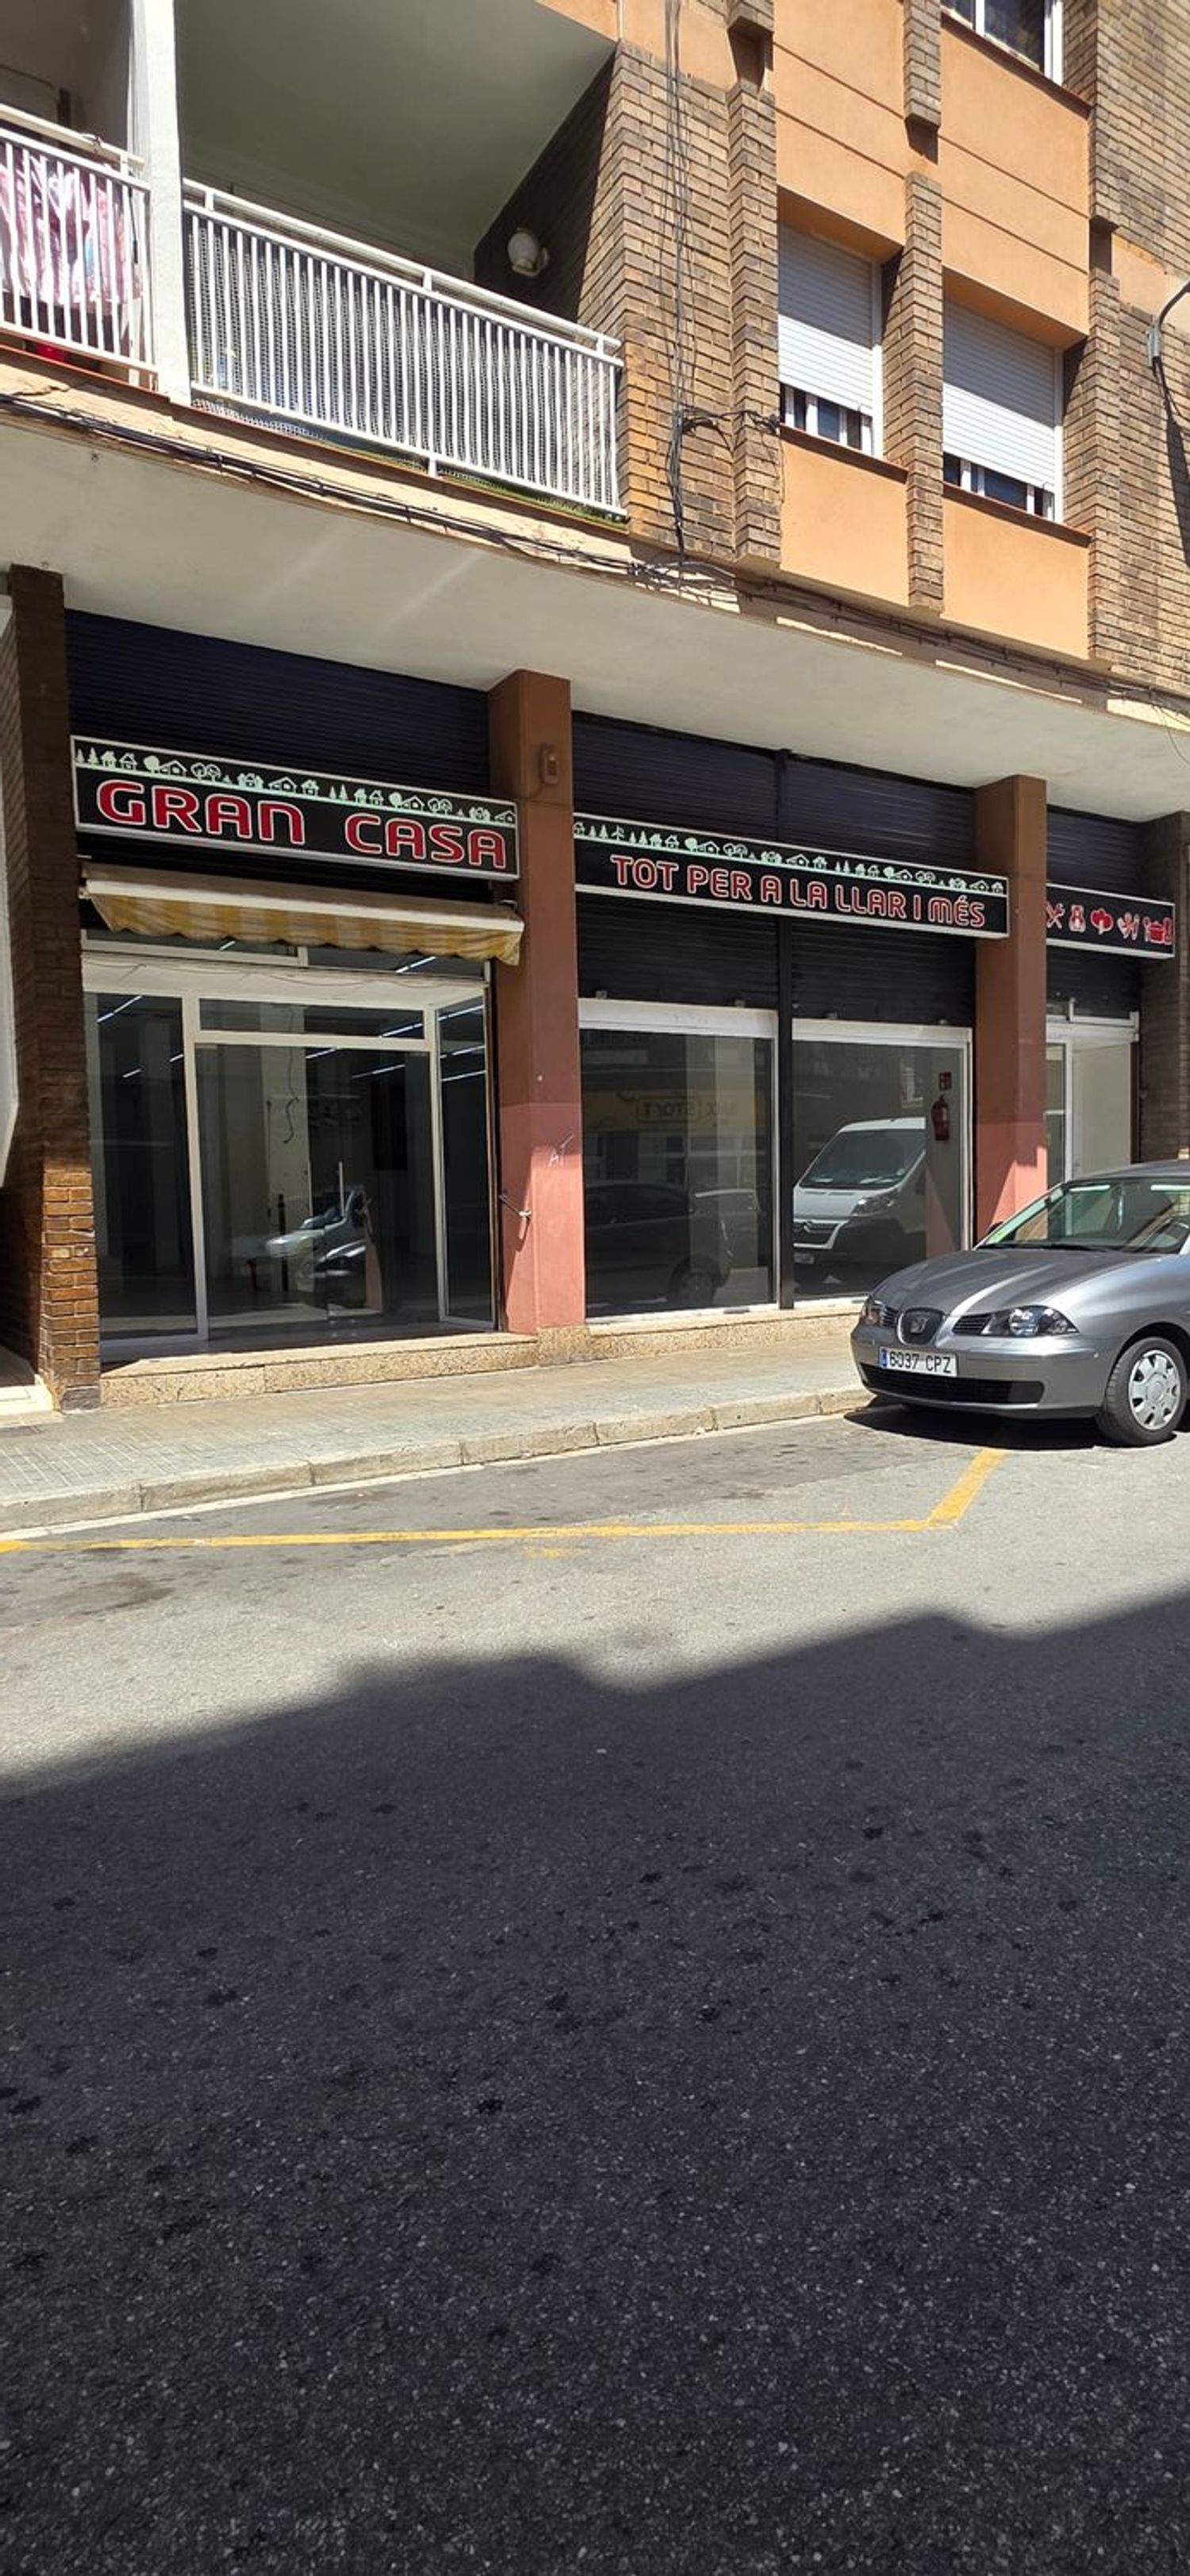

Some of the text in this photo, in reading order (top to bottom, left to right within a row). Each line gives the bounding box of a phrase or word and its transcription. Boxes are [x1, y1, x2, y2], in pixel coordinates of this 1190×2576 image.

[94, 779, 508, 869] GRAN CASA
[610, 854, 985, 927] TOT PER A LA LLAR I MÉS
[889, 1351, 951, 1374] 6037 CPZ
